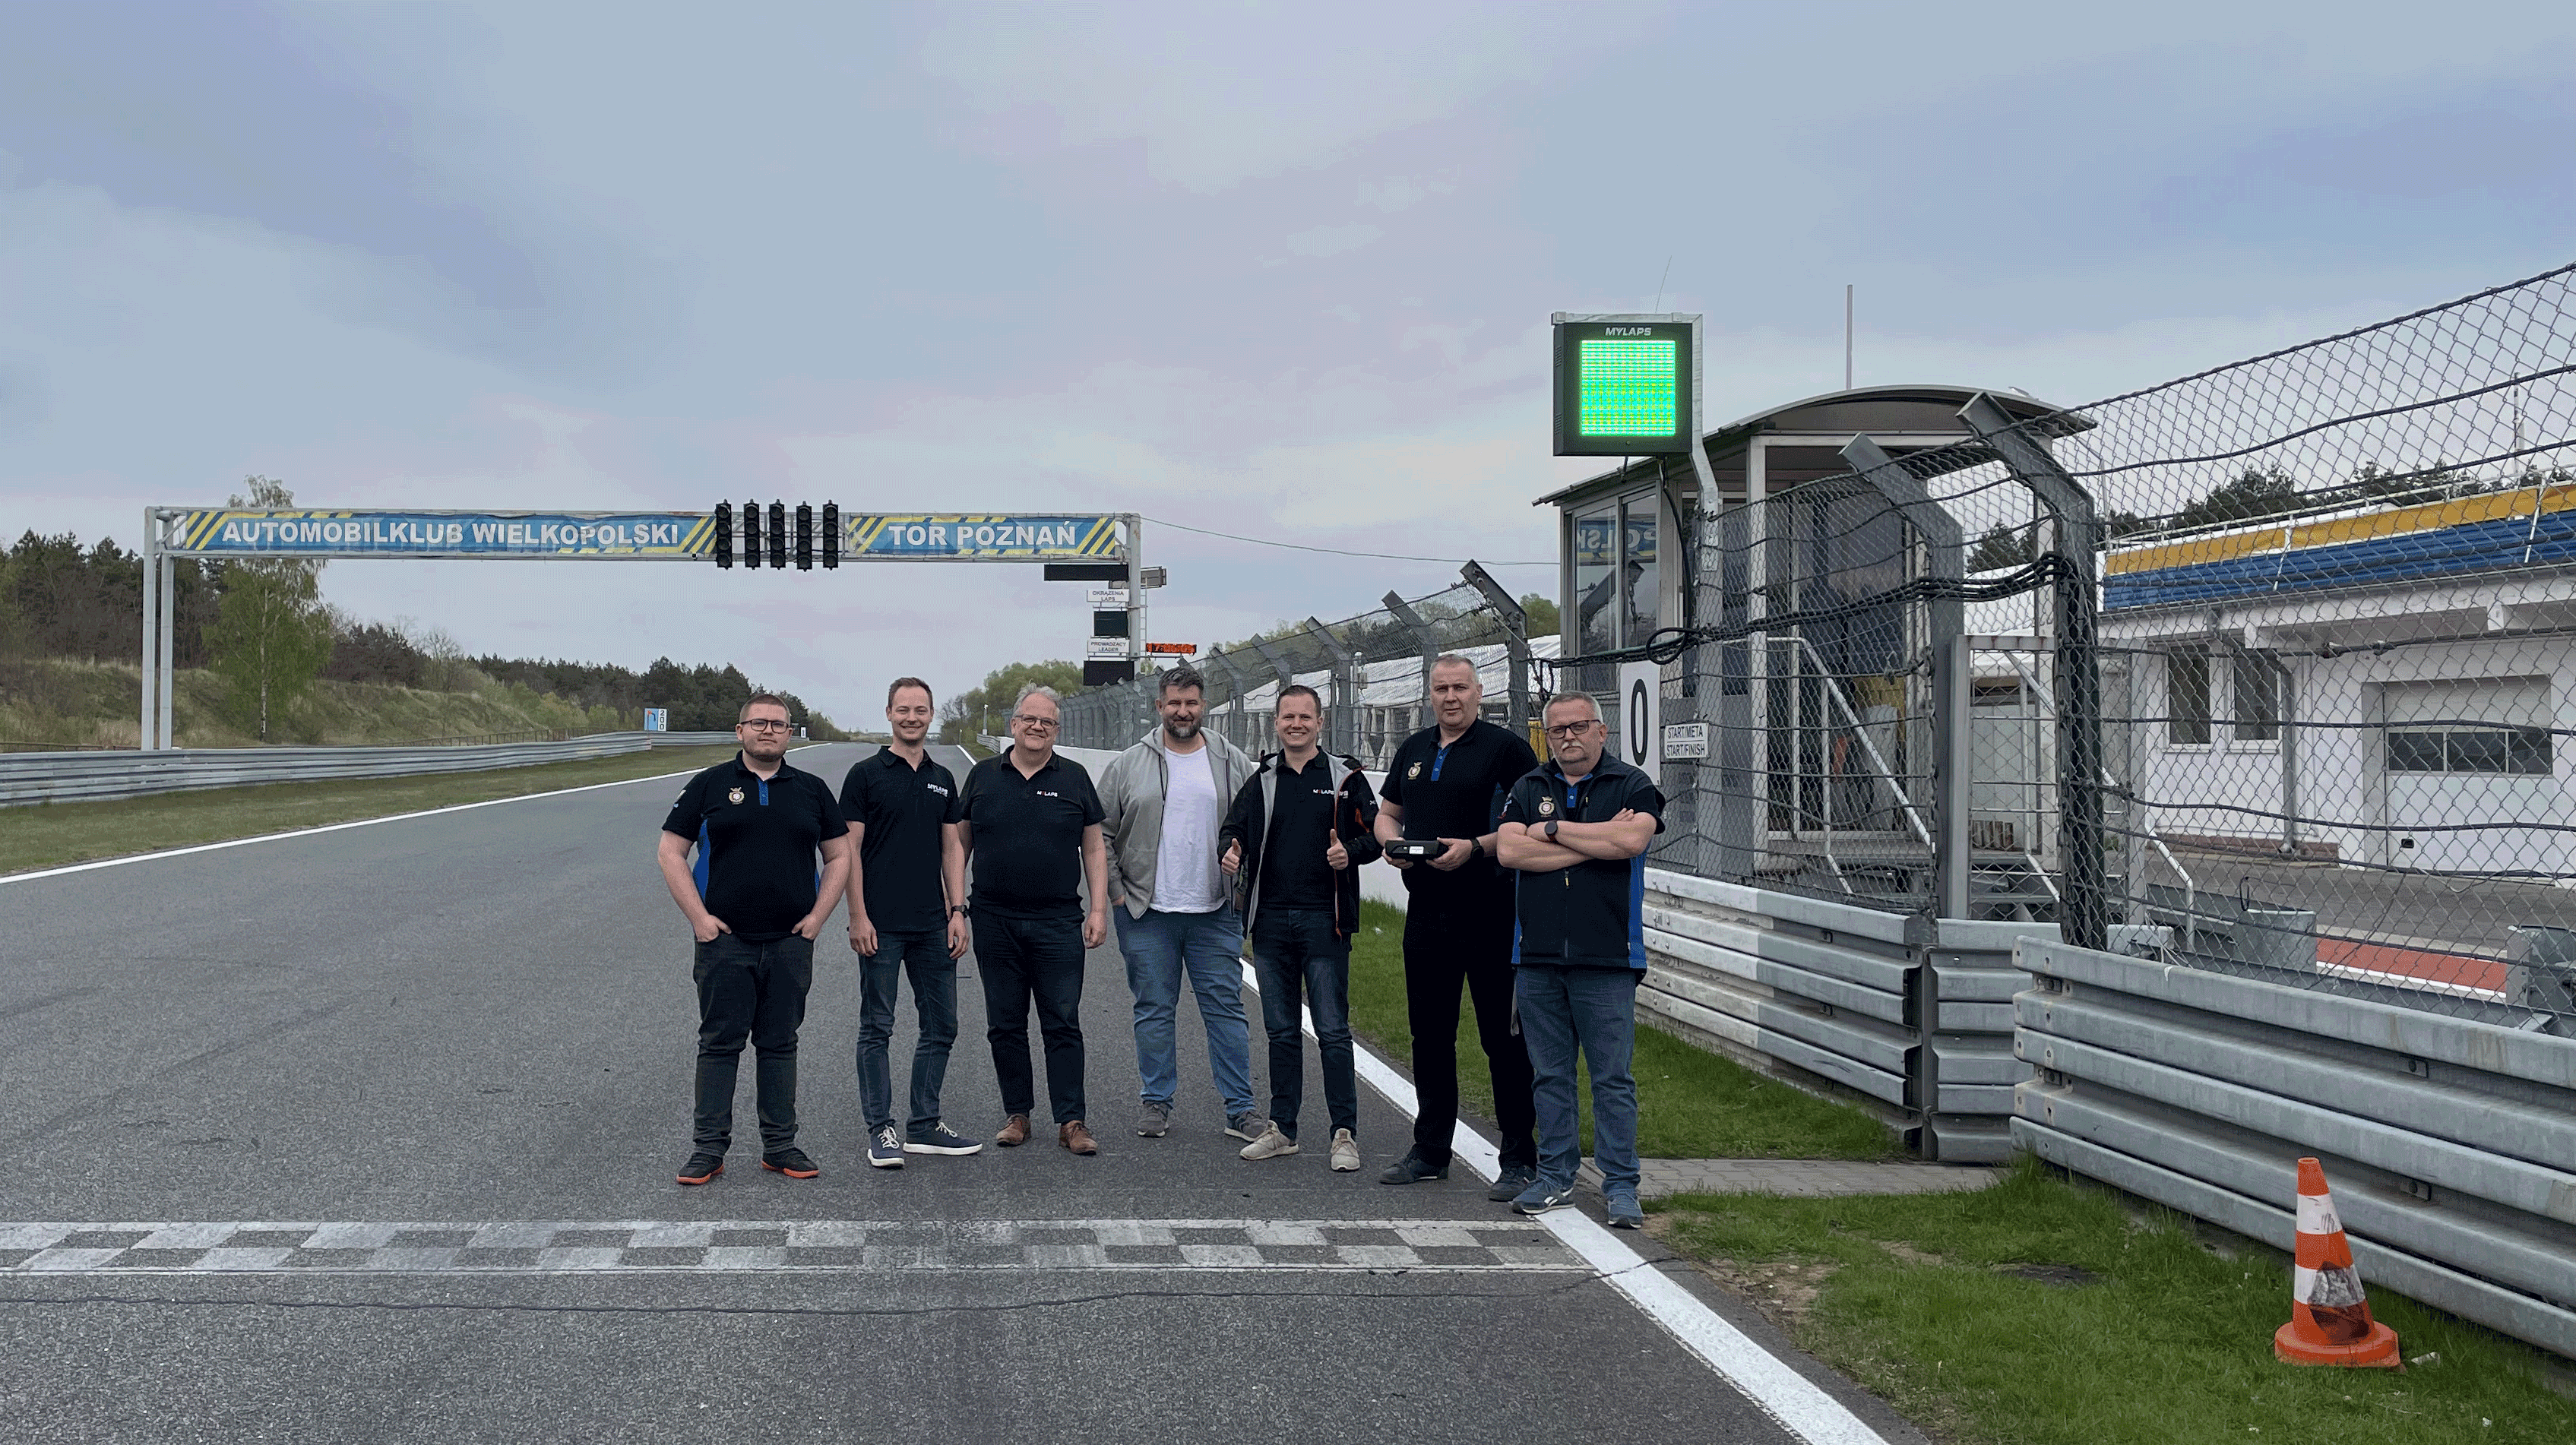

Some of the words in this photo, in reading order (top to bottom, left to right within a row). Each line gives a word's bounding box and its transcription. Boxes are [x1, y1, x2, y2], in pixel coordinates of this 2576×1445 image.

[1605, 327, 1652, 336] MYLAPS
[222, 522, 463, 544] AUTOMOBILKLUB
[472, 523, 679, 545] WIELKOPOLSKI
[888, 526, 948, 545] TOR
[957, 520, 1076, 545] POZNAŃ
[1631, 678, 1648, 766] 0
[1667, 725, 1704, 739] START/META
[1666, 743, 1705, 757] START/FINISH
